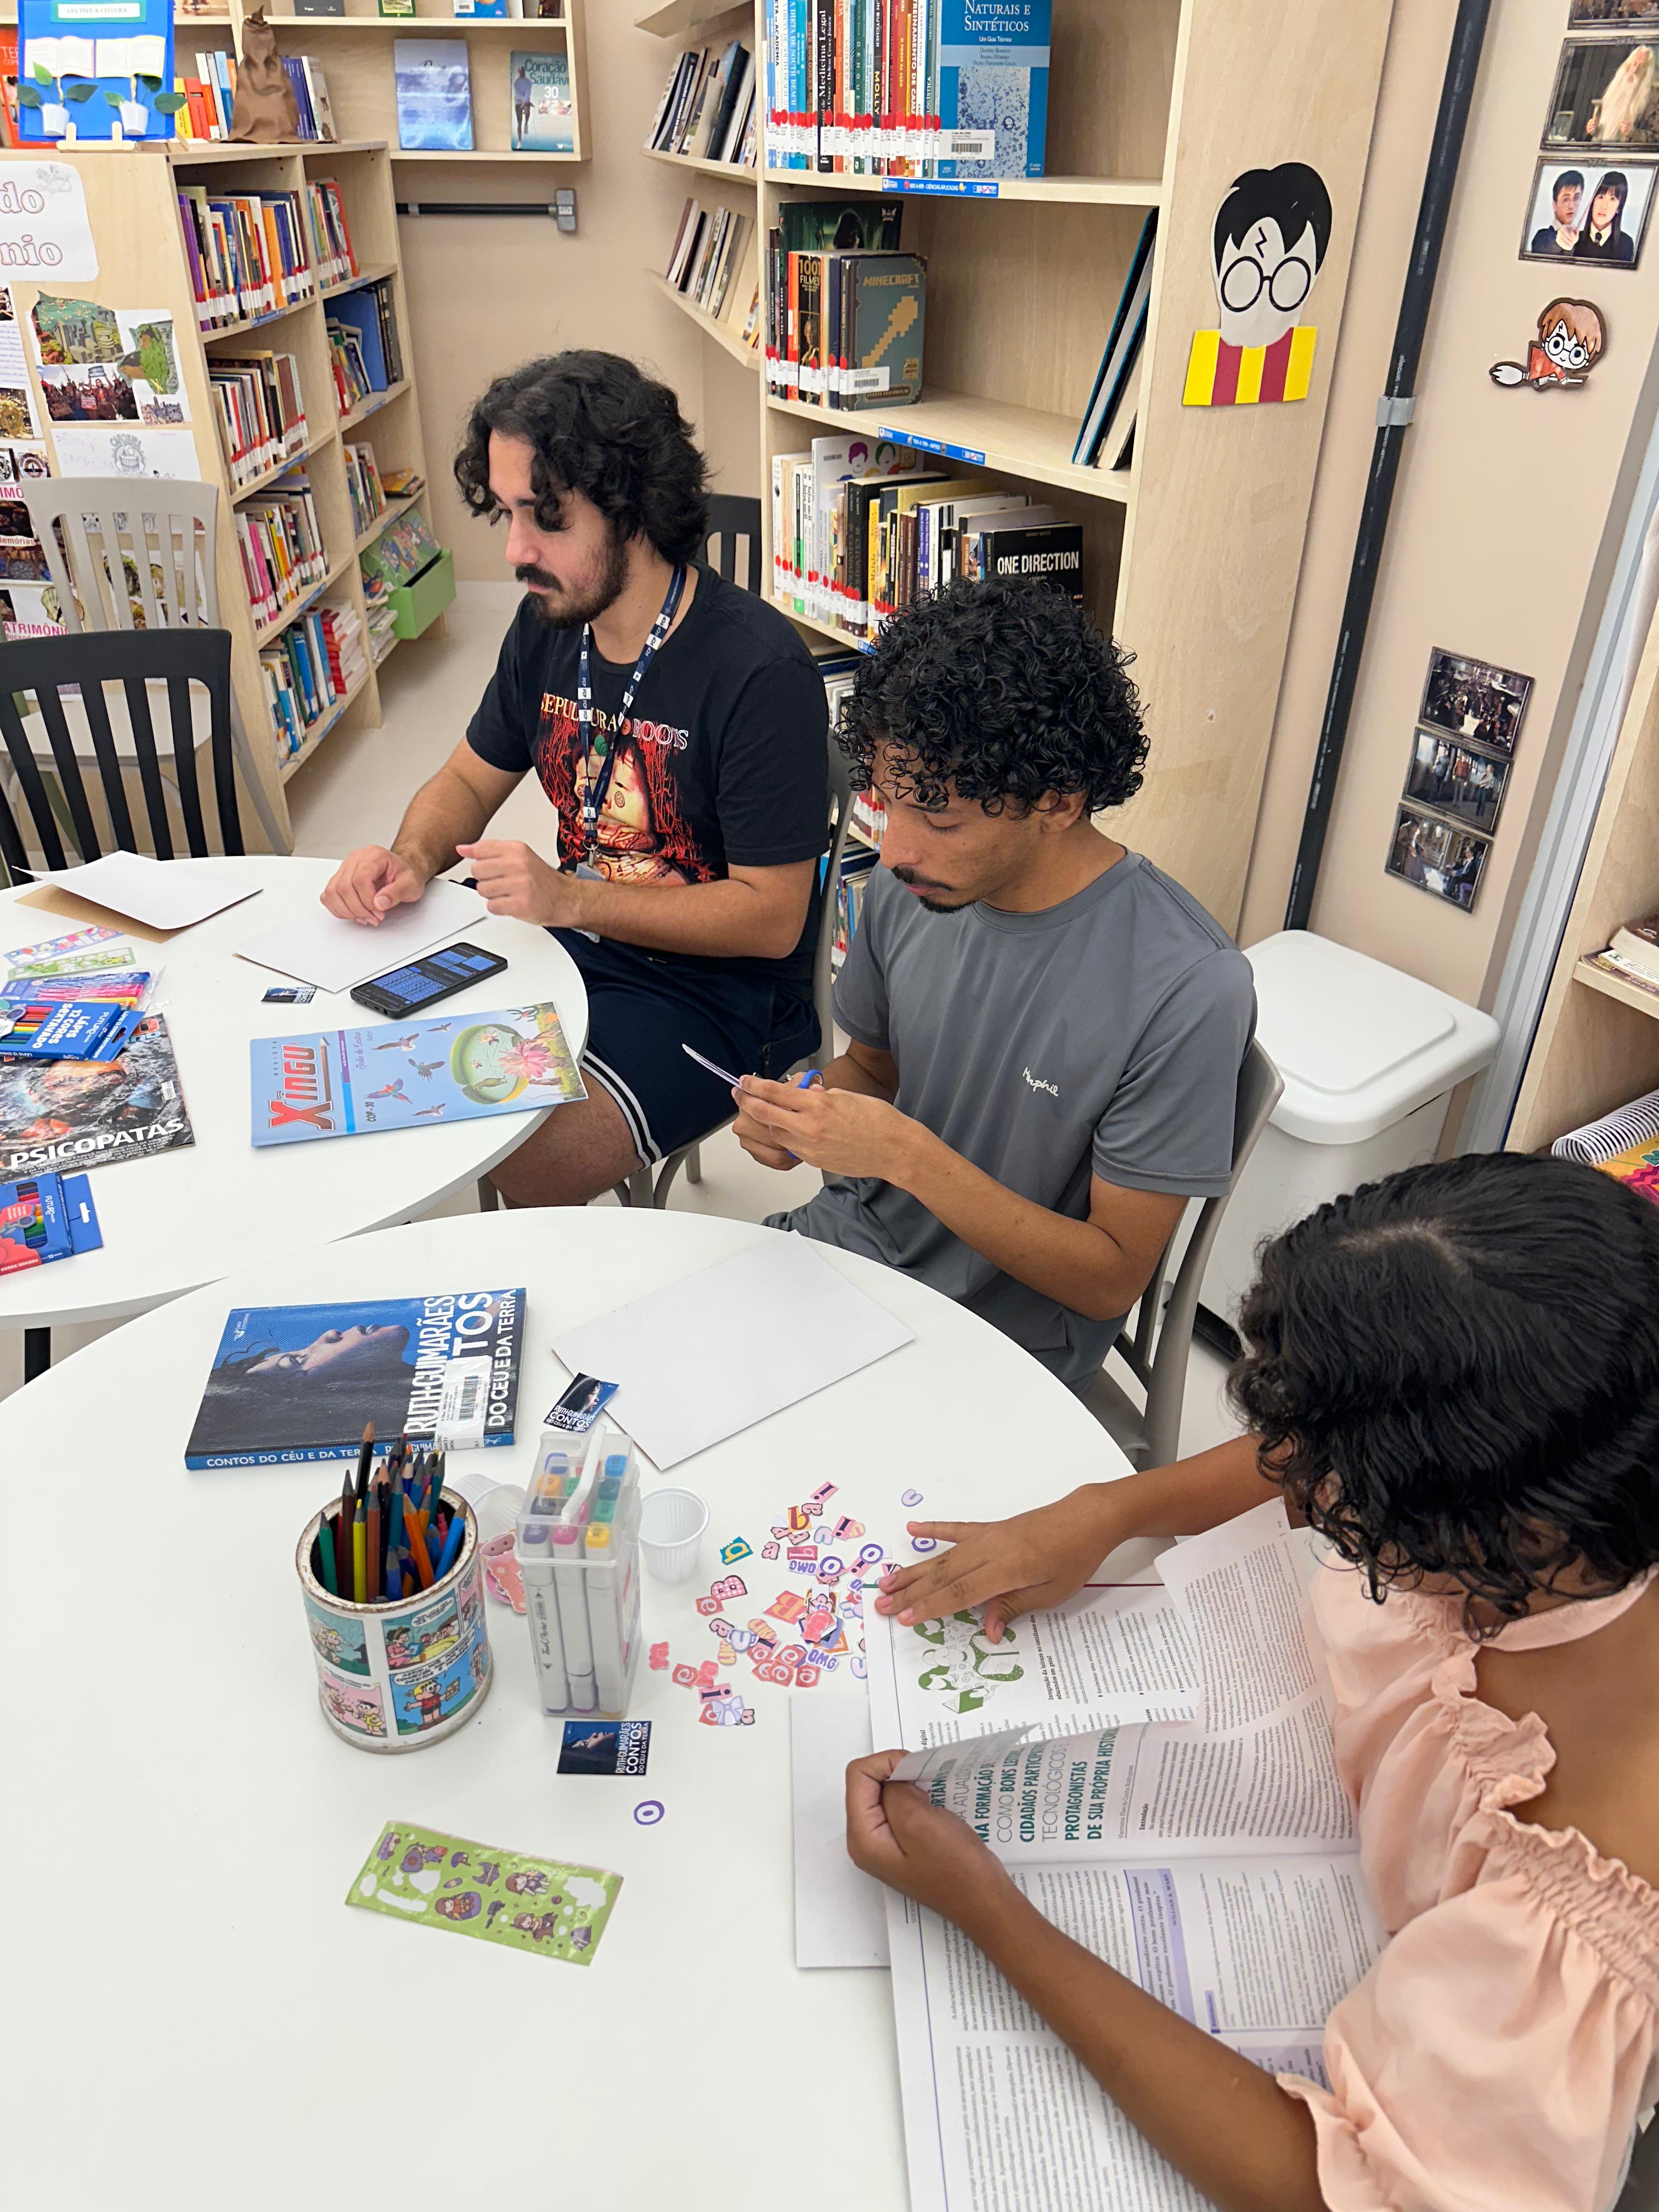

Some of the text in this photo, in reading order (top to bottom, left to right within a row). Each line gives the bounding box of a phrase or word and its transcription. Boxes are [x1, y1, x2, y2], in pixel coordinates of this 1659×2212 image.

[819, 10, 827, 41] Legal
[964, 15, 1029, 32] SINTÉTICOS
[525, 59, 566, 75] Coração
[911, 72, 916, 86] DE
[544, 86, 559, 99] 30
[798, 259, 821, 276] 1001
[862, 273, 919, 284] MINECRAFT
[997, 550, 1079, 575] ONE DIRECTION
[632, 718, 690, 750] ROOTS
[71, 1009, 83, 1018] 12
[66, 1015, 91, 1039] LÁPIS
[10, 1118, 184, 1169] PSICOPATAS
[497, 1289, 517, 1334] TERRA
[452, 1292, 494, 1356] TOS
[495, 1335, 514, 1358] DA
[494, 1358, 511, 1369] E
[488, 1402, 507, 1427] DO
[549, 1411, 591, 1428] CONTOS
[206, 1446, 377, 1468] CONTOS DO CÉU E DA TERA
[1032, 1624, 1043, 1645] cotidiano
[1039, 1654, 1047, 1669] leitura
[1046, 1655, 1058, 1671] geral
[1043, 1675, 1054, 1701] Integração
[1051, 1680, 1063, 1700] educandos
[625, 1722, 642, 1774] CONTOS
[641, 1741, 647, 1750] DA
[638, 1764, 645, 1773] DO
[973, 1770, 996, 1819] FORMAÇÃO
[997, 1769, 1017, 1843] COMO BONS
[1064, 1761, 1088, 1841] PROTAGONISTAS
[1086, 1759, 1112, 1840] DE SUA PRÓPRIA
[1018, 1789, 1038, 1843] CIDADÃOS
[1133, 1876, 1143, 1904] professor
[1163, 1874, 1171, 1891] WARD
[1146, 1896, 1156, 1927] professor
[1159, 1921, 1167, 1953] excelente
